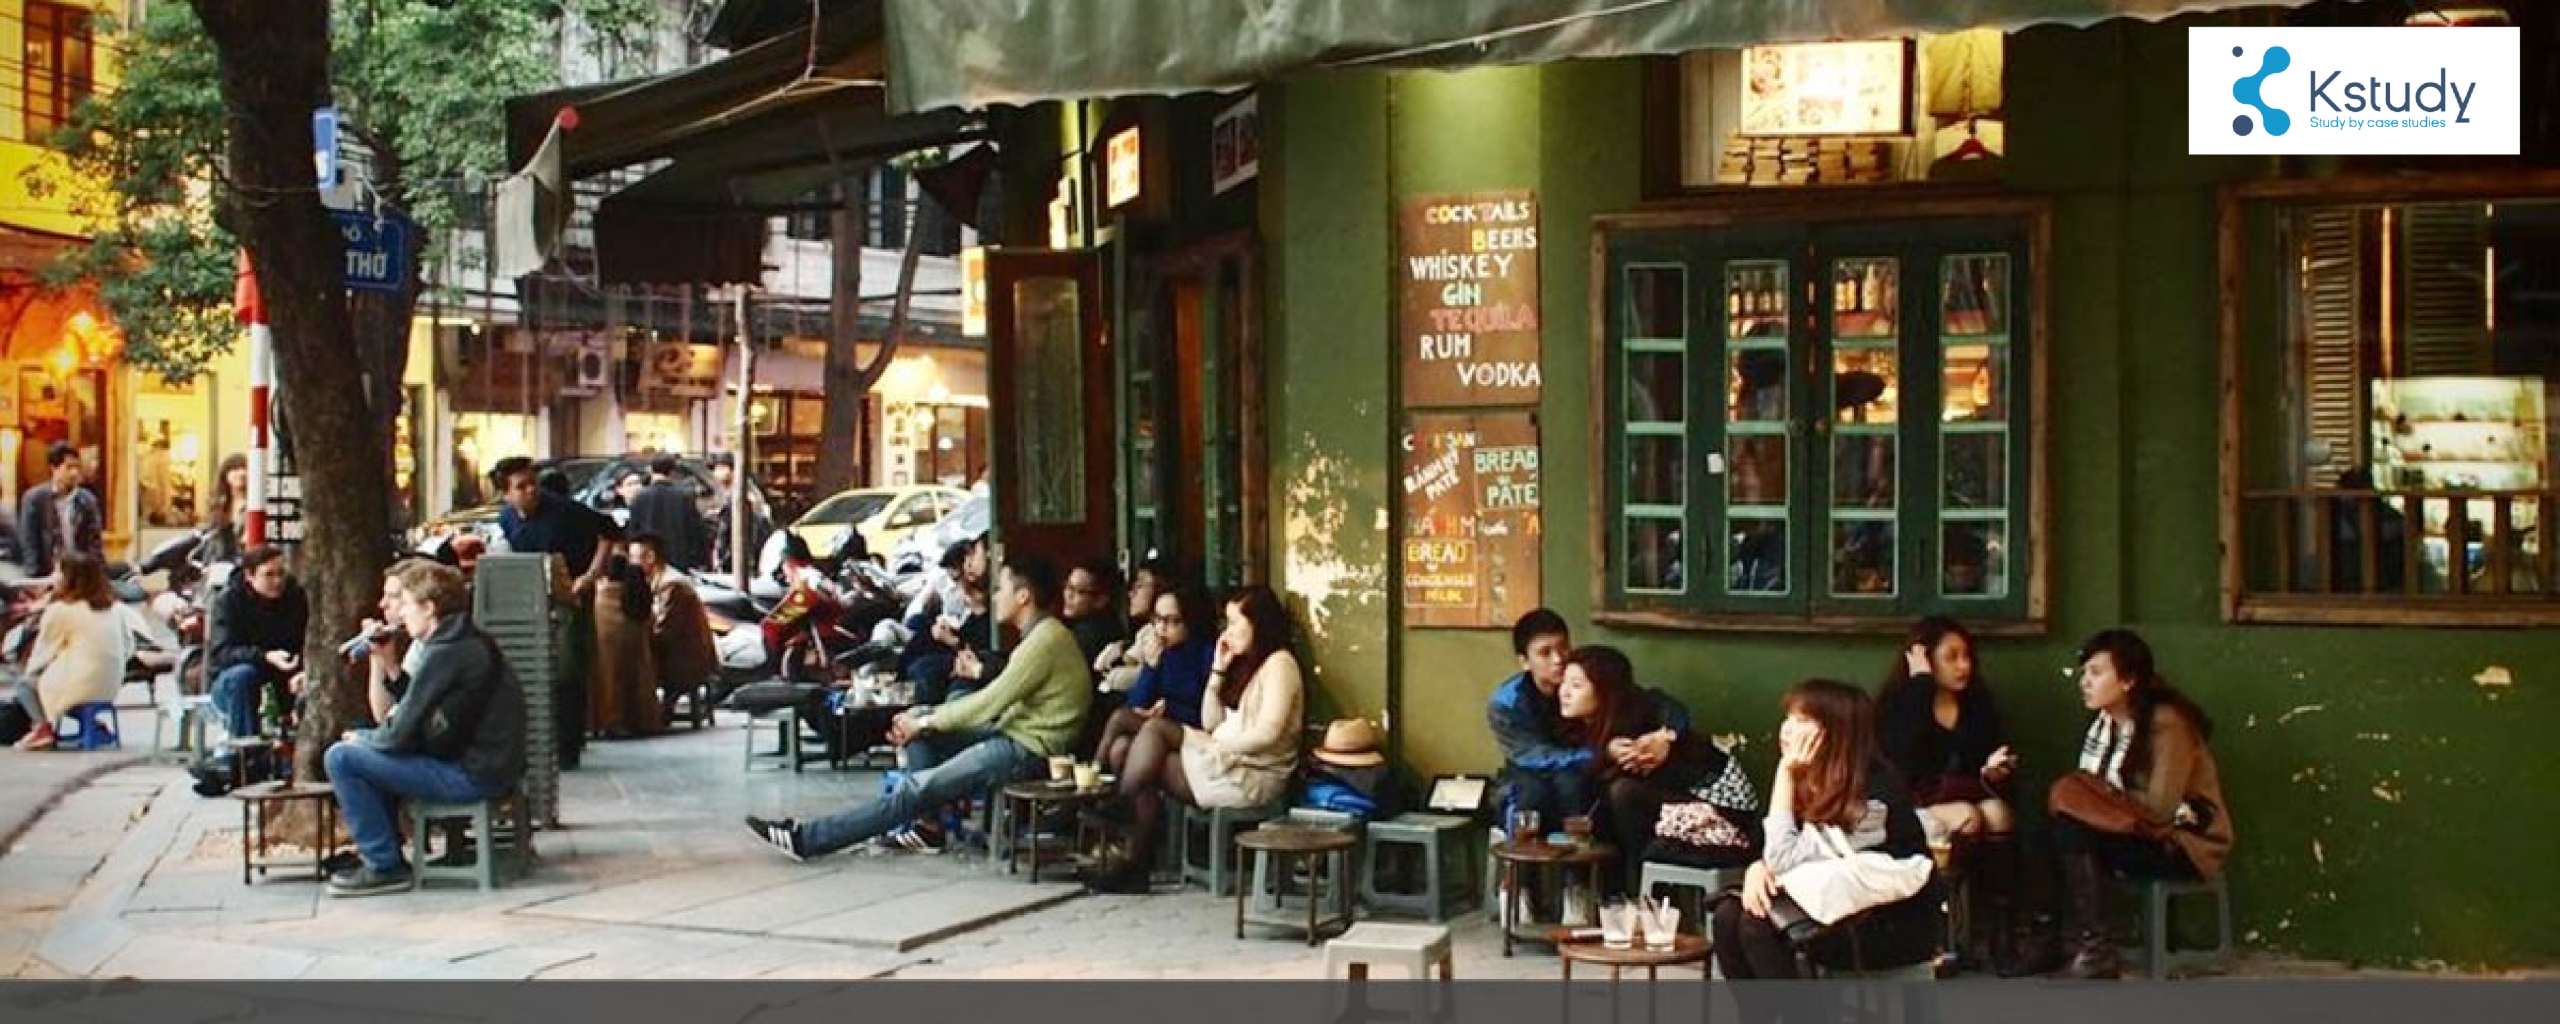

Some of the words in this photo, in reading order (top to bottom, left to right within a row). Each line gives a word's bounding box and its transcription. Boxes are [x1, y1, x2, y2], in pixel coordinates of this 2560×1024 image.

[1472, 226, 1537, 251] BEERS
[1420, 334, 1471, 359] RUM
[1457, 362, 1541, 387] VODKA
[1475, 449, 1537, 474] BREAD
[1408, 543, 1466, 562] BREAD
